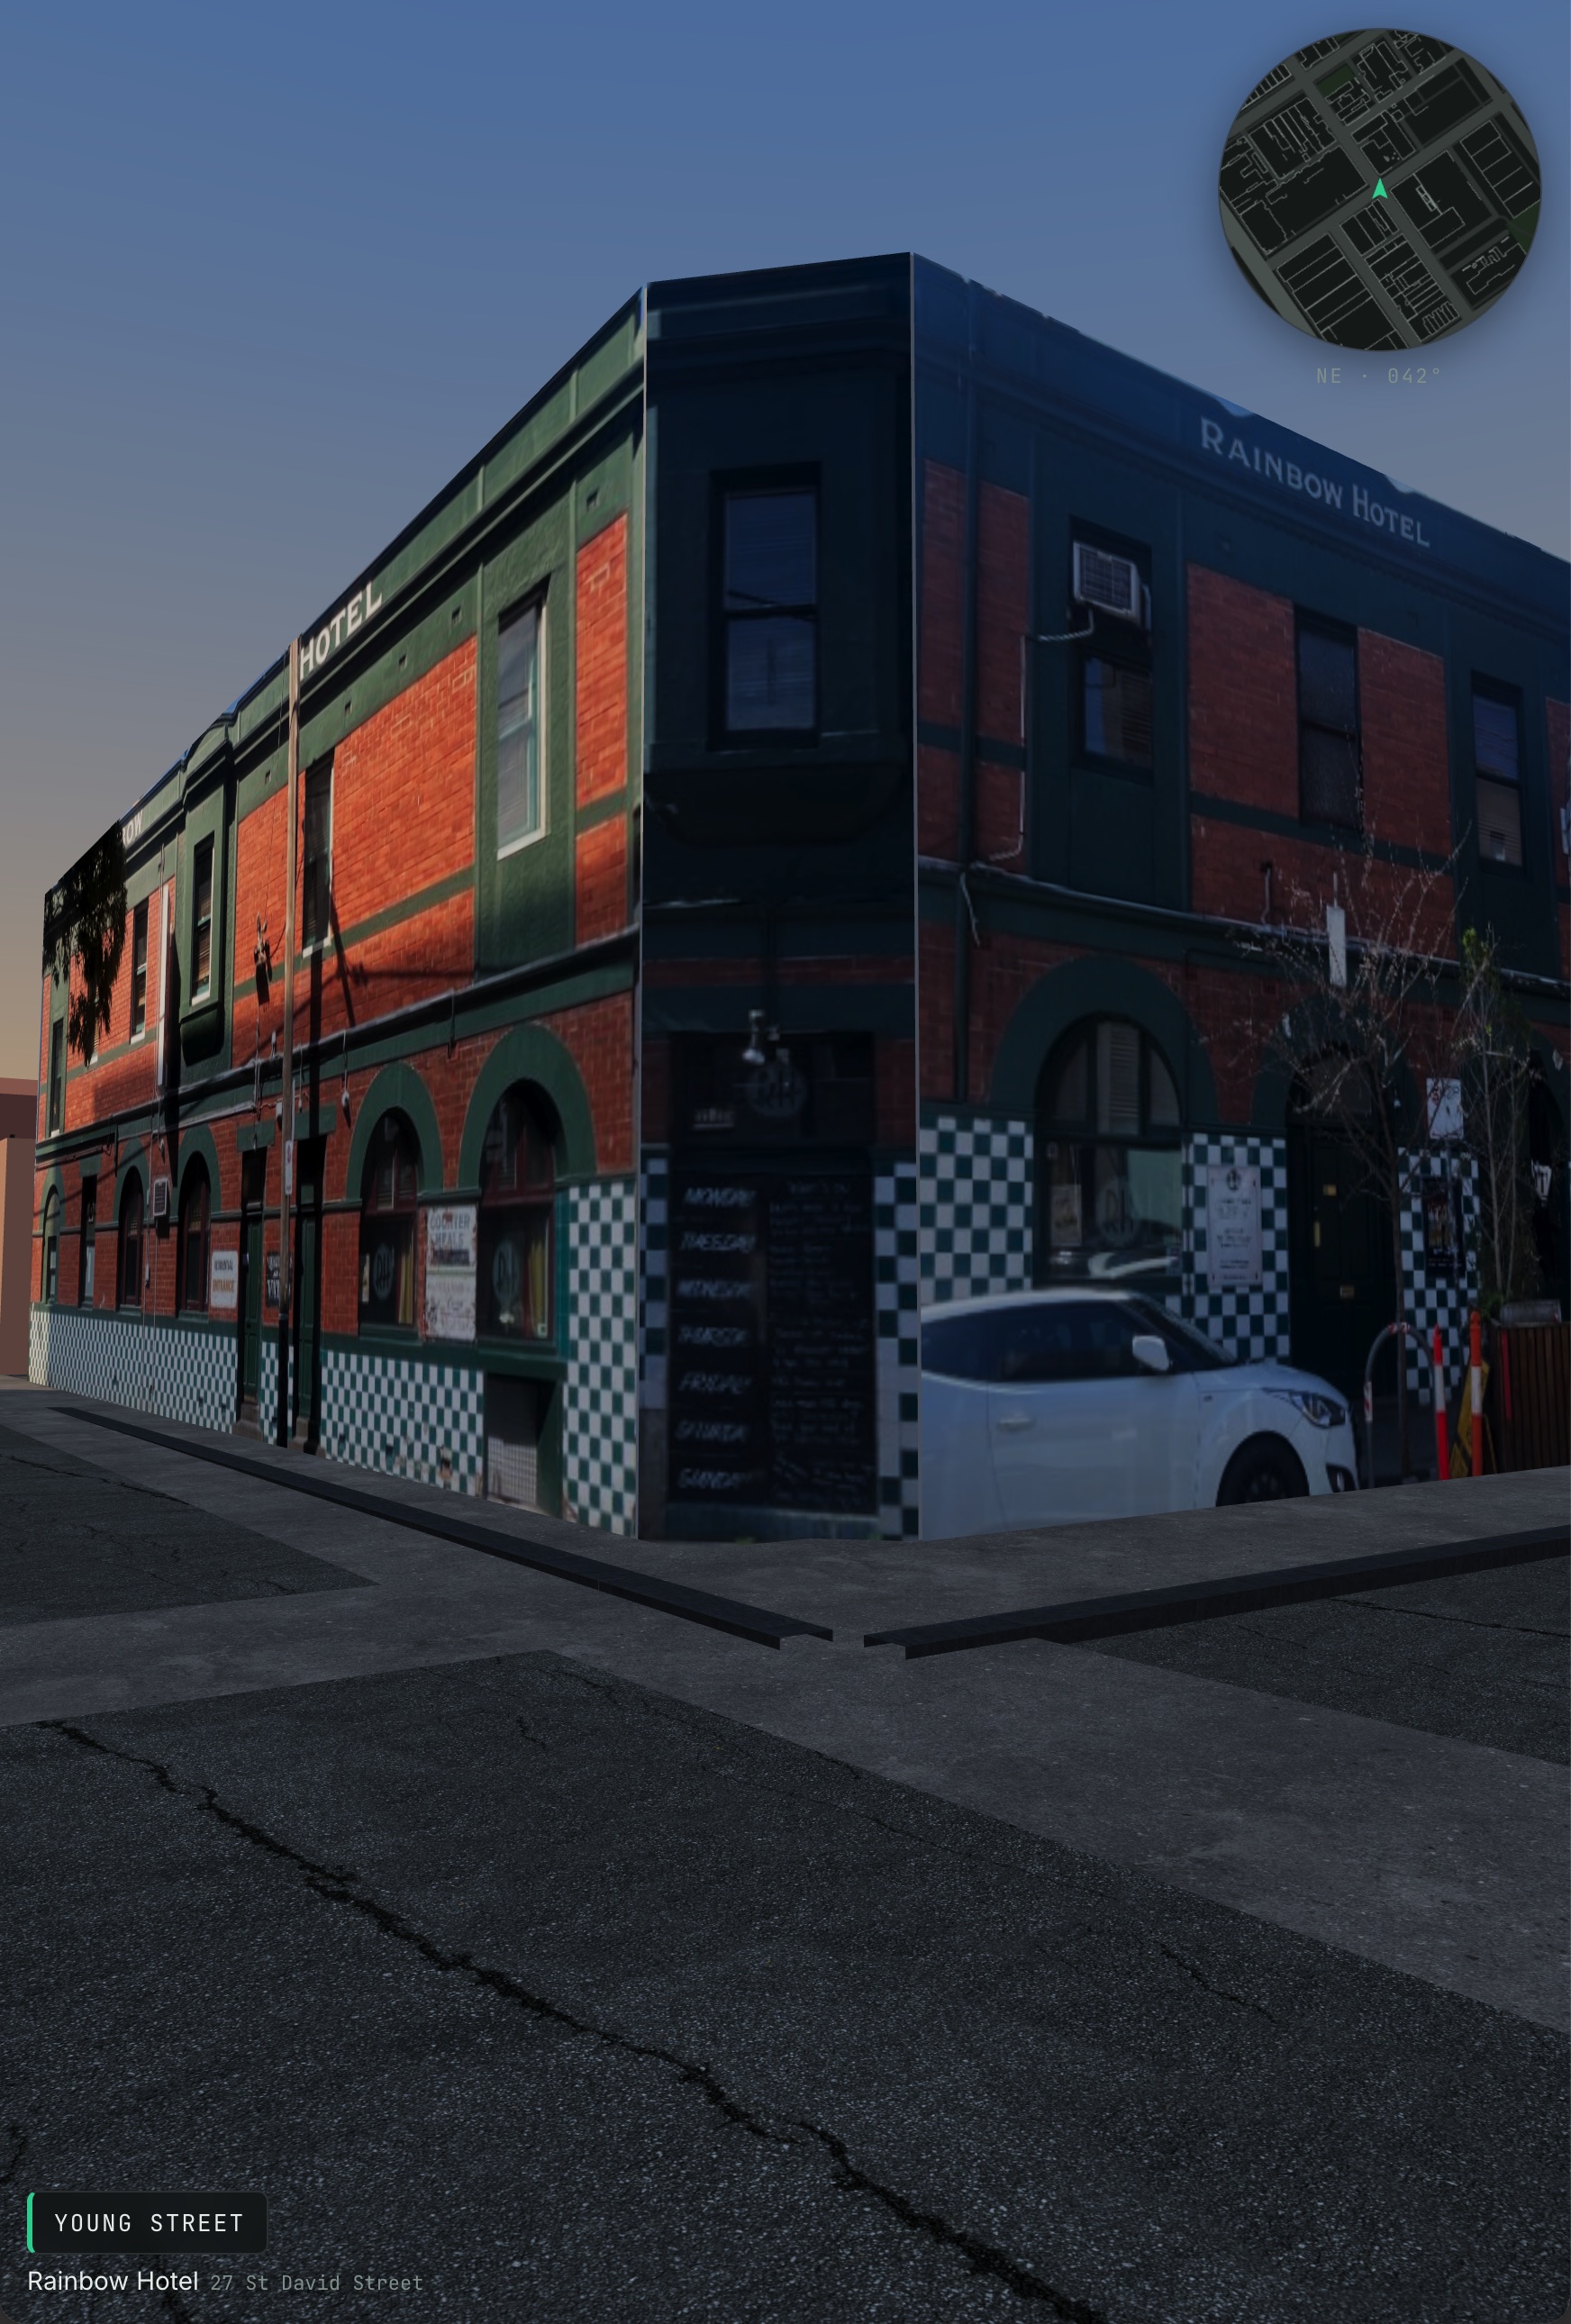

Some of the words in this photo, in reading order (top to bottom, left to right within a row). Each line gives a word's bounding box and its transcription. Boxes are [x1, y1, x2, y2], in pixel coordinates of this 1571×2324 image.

[1201, 416, 1342, 510] RAINBOW
[1352, 483, 1430, 549] HOTEL
[299, 581, 383, 682] HOTEL
